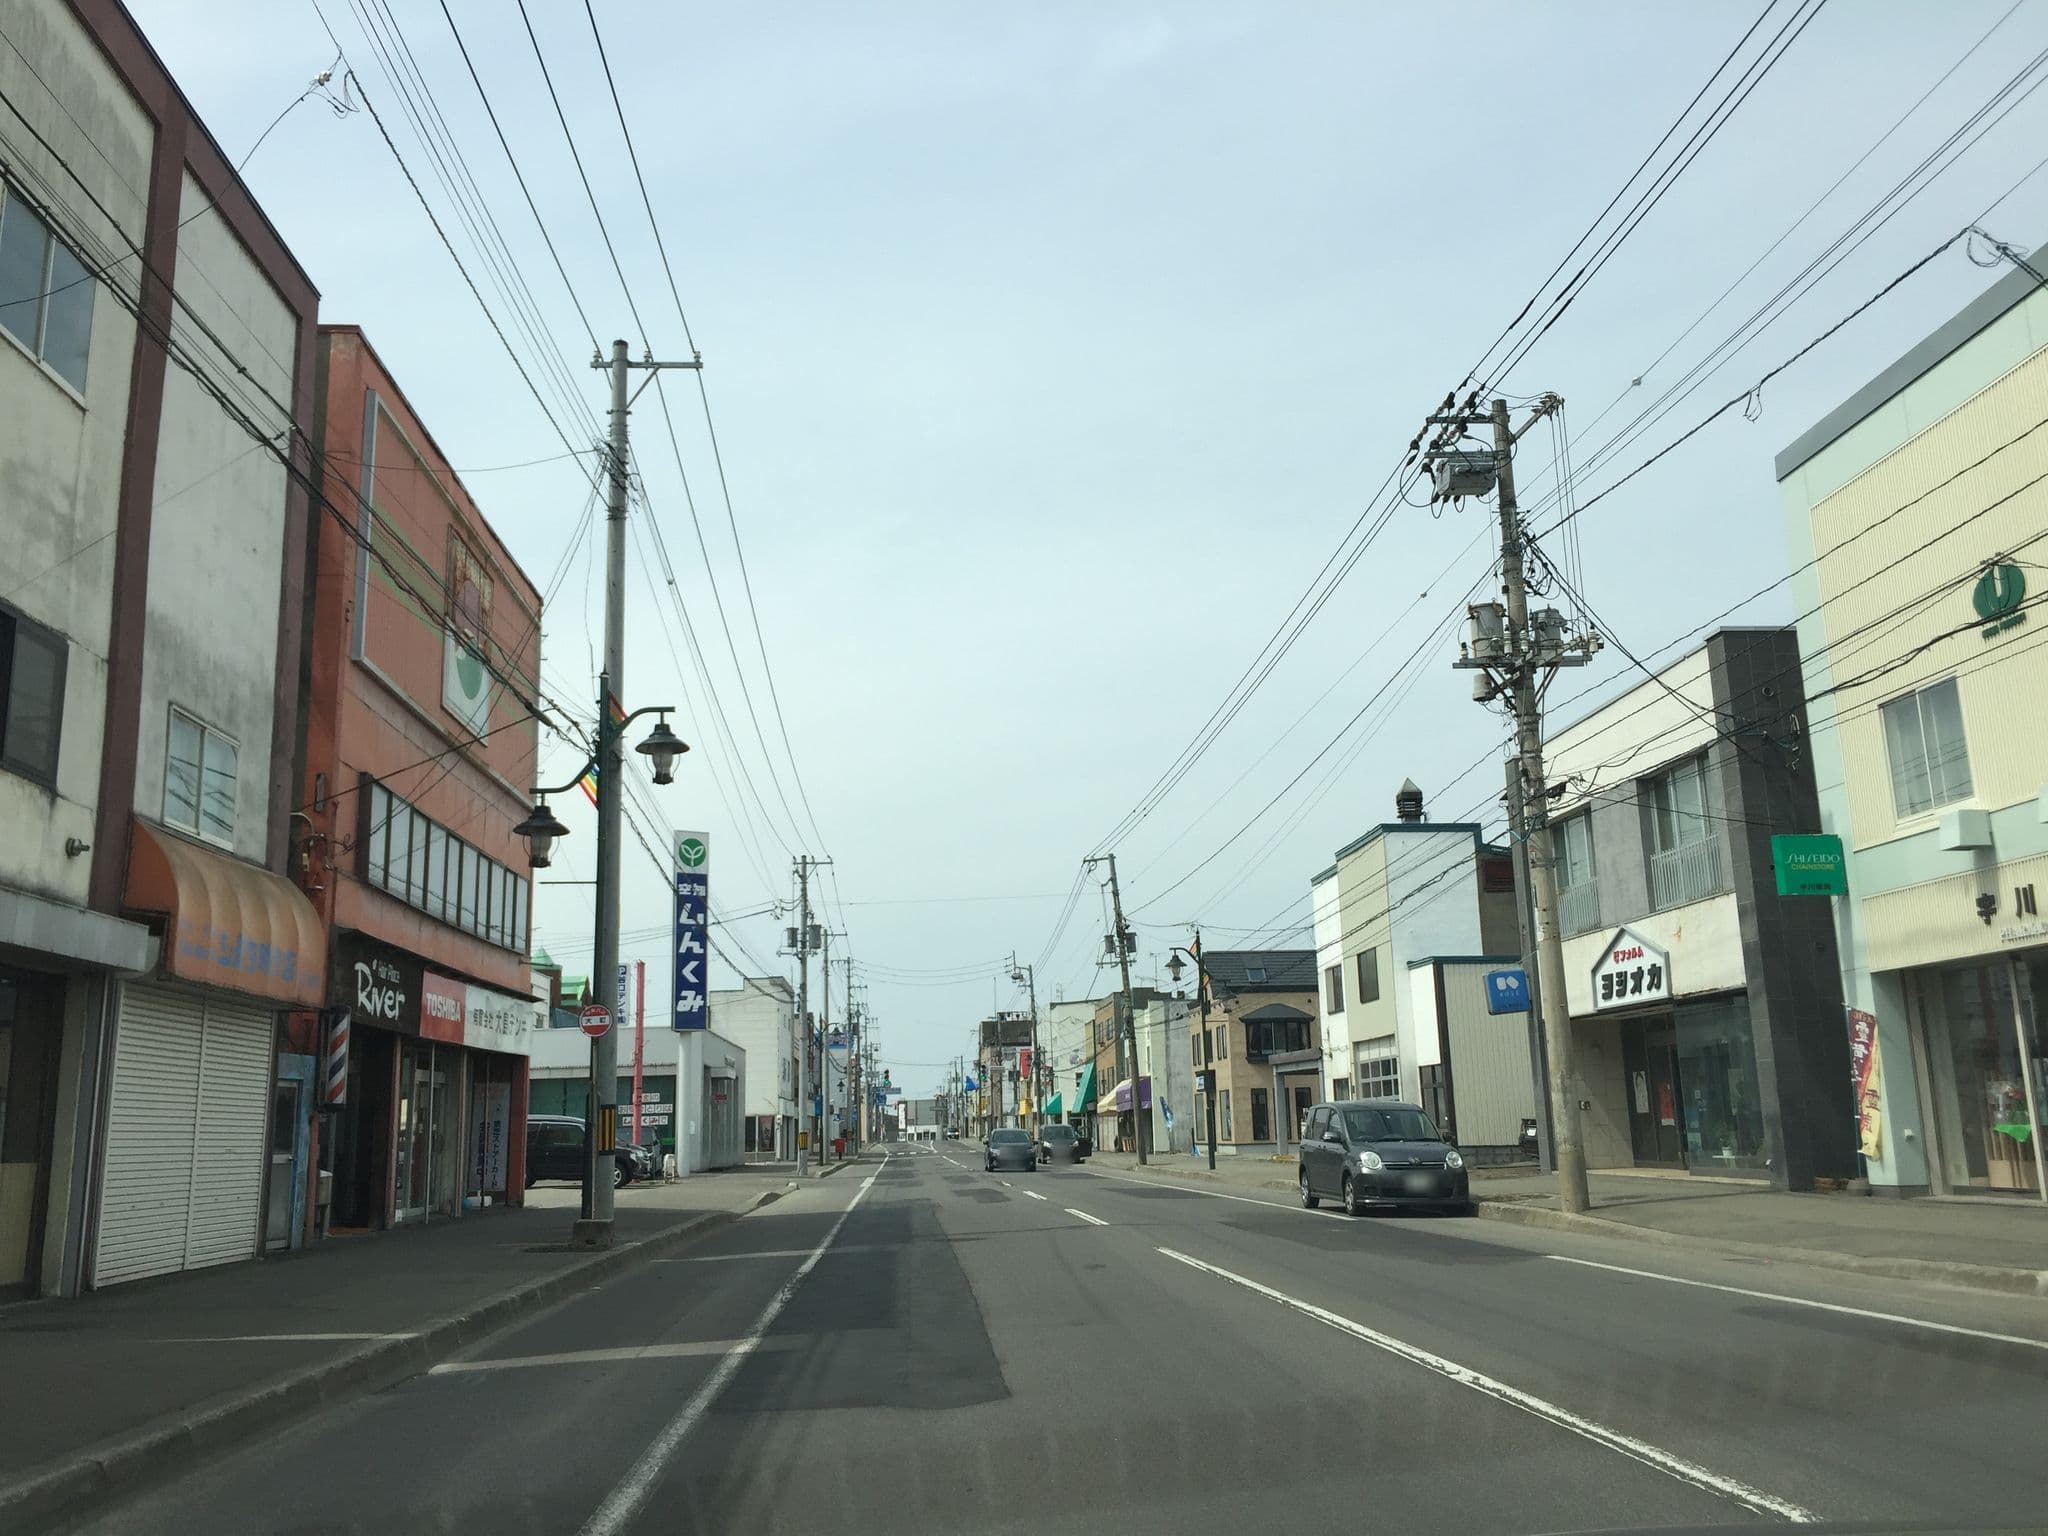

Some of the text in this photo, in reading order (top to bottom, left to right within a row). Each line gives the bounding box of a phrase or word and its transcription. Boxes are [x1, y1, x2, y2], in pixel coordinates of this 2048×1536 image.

[1785, 853, 1840, 864] SHISEIDO
[677, 903, 705, 1012] しんくみ
[354, 959, 405, 1021] River
[1601, 963, 1662, 1001] ヨシオカ
[426, 992, 461, 1023] TOSHIBA
